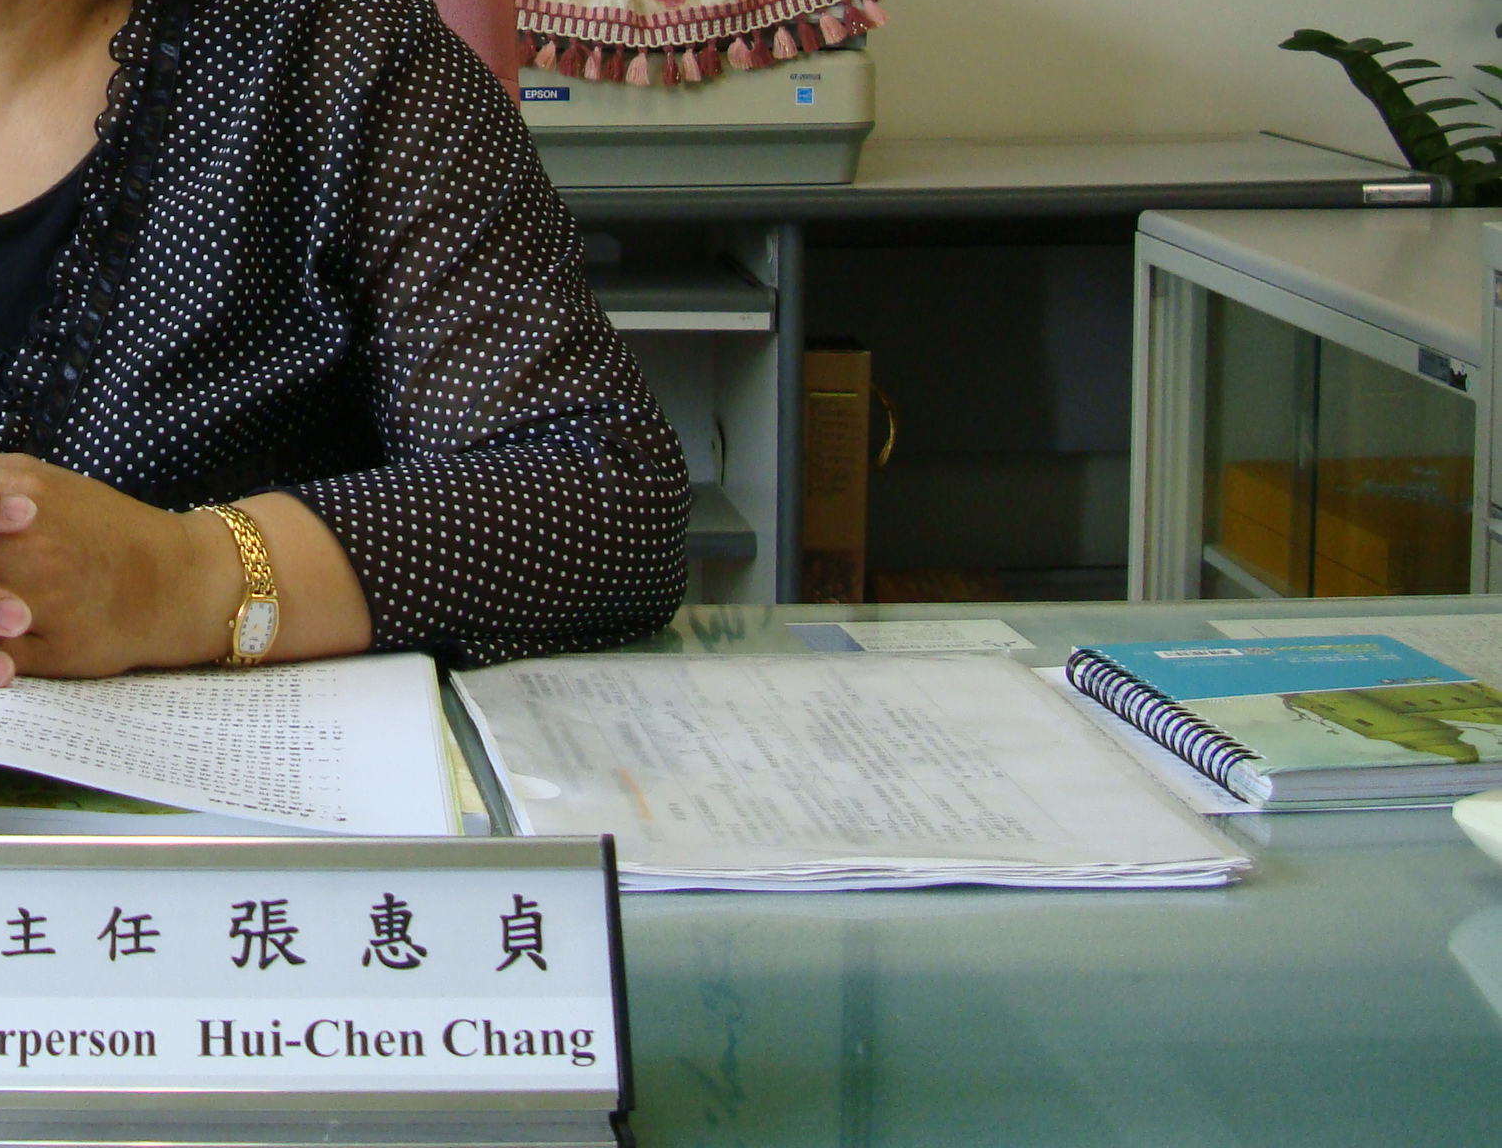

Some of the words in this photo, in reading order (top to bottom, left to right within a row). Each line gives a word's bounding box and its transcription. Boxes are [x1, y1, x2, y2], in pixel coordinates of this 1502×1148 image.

[525, 89, 558, 100] EPSON
[229, 892, 549, 972] 張惠貞
[198, 1019, 426, 1058] Hui-Chen
[442, 1019, 597, 1067] Chang
